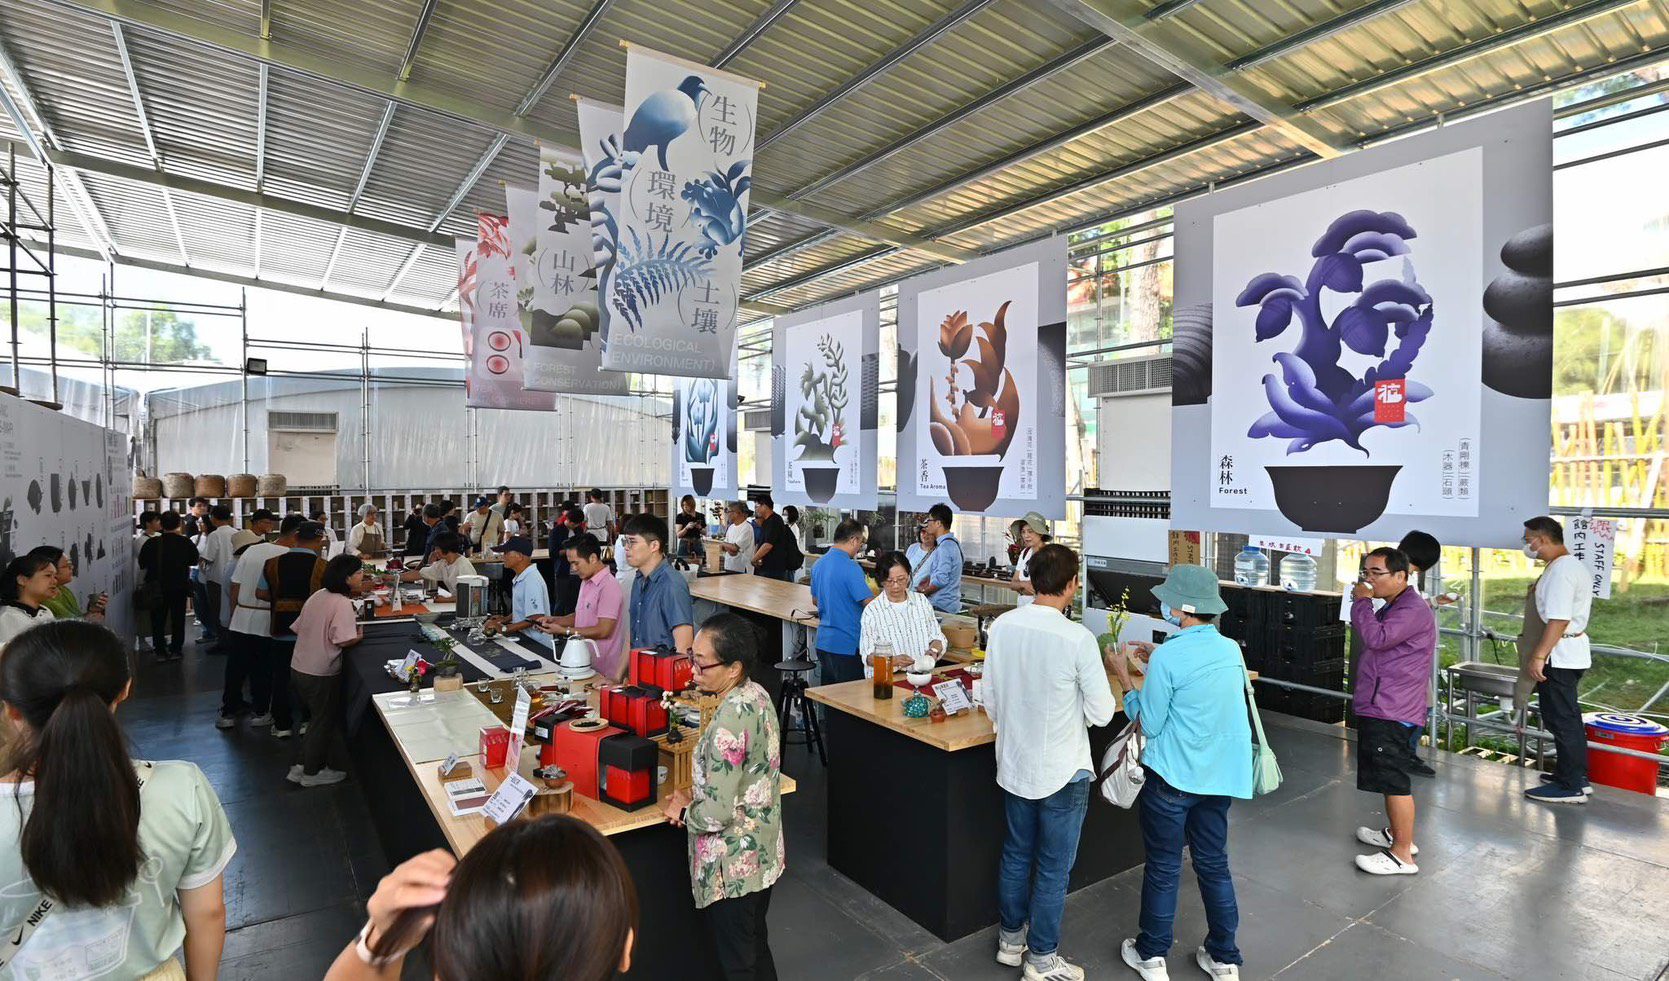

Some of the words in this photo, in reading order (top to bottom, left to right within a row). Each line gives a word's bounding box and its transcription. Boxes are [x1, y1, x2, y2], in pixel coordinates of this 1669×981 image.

[613, 332, 704, 353] ECOLOGICAL
[920, 458, 929, 482] 茶香
[1219, 454, 1233, 485] 森林
[1219, 487, 1247, 495] Forest
[1594, 542, 1605, 571] STAFF
[1592, 574, 1603, 597] ONLY
[27, 899, 52, 927] NIKE
